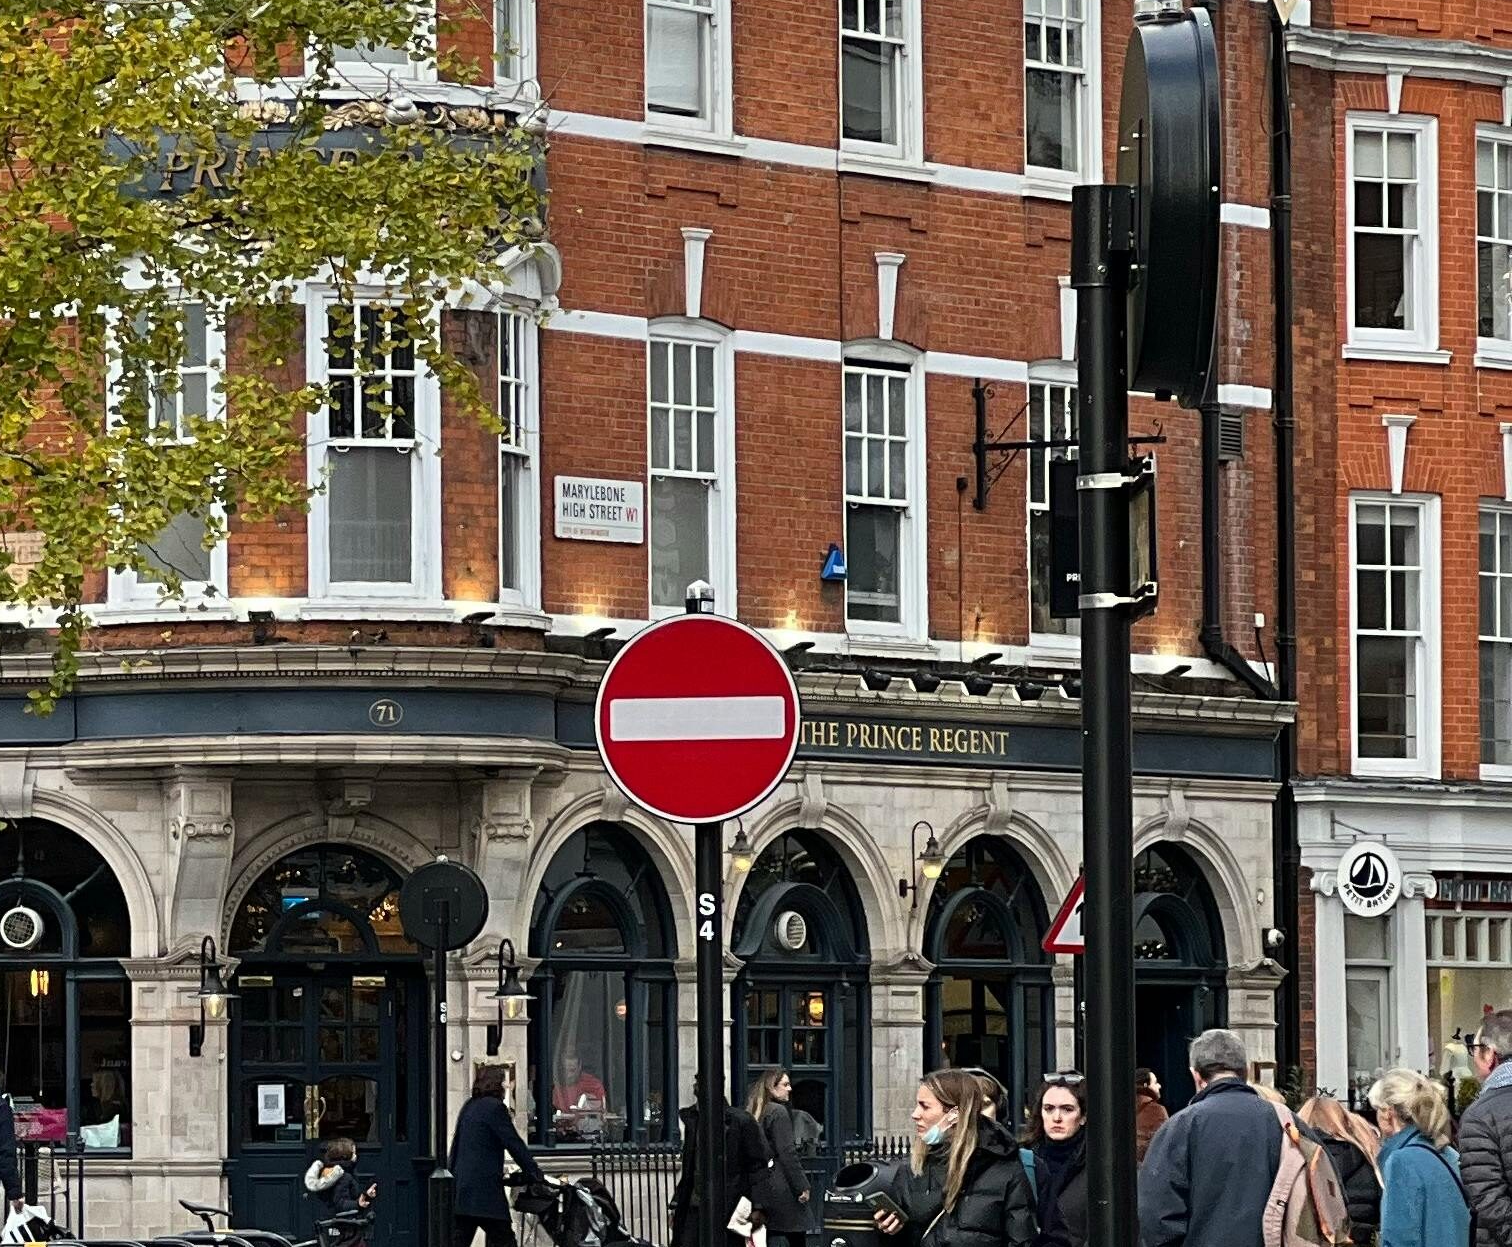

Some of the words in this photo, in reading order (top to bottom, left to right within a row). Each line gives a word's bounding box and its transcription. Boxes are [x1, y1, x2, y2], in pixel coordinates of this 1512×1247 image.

[562, 482, 625, 502] MARYLEBONE
[562, 502, 586, 518] HIGH
[589, 504, 623, 521] STREET
[626, 507, 638, 522] W1
[376, 705, 395, 722] 71
[800, 721, 839, 746] THE
[846, 723, 922, 751] PRINCE
[928, 728, 1009, 755] REGENT
[699, 893, 716, 916] S
[1343, 883, 1364, 906] PETIT
[1367, 882, 1395, 908] BATEAU
[699, 920, 715, 941] 4
